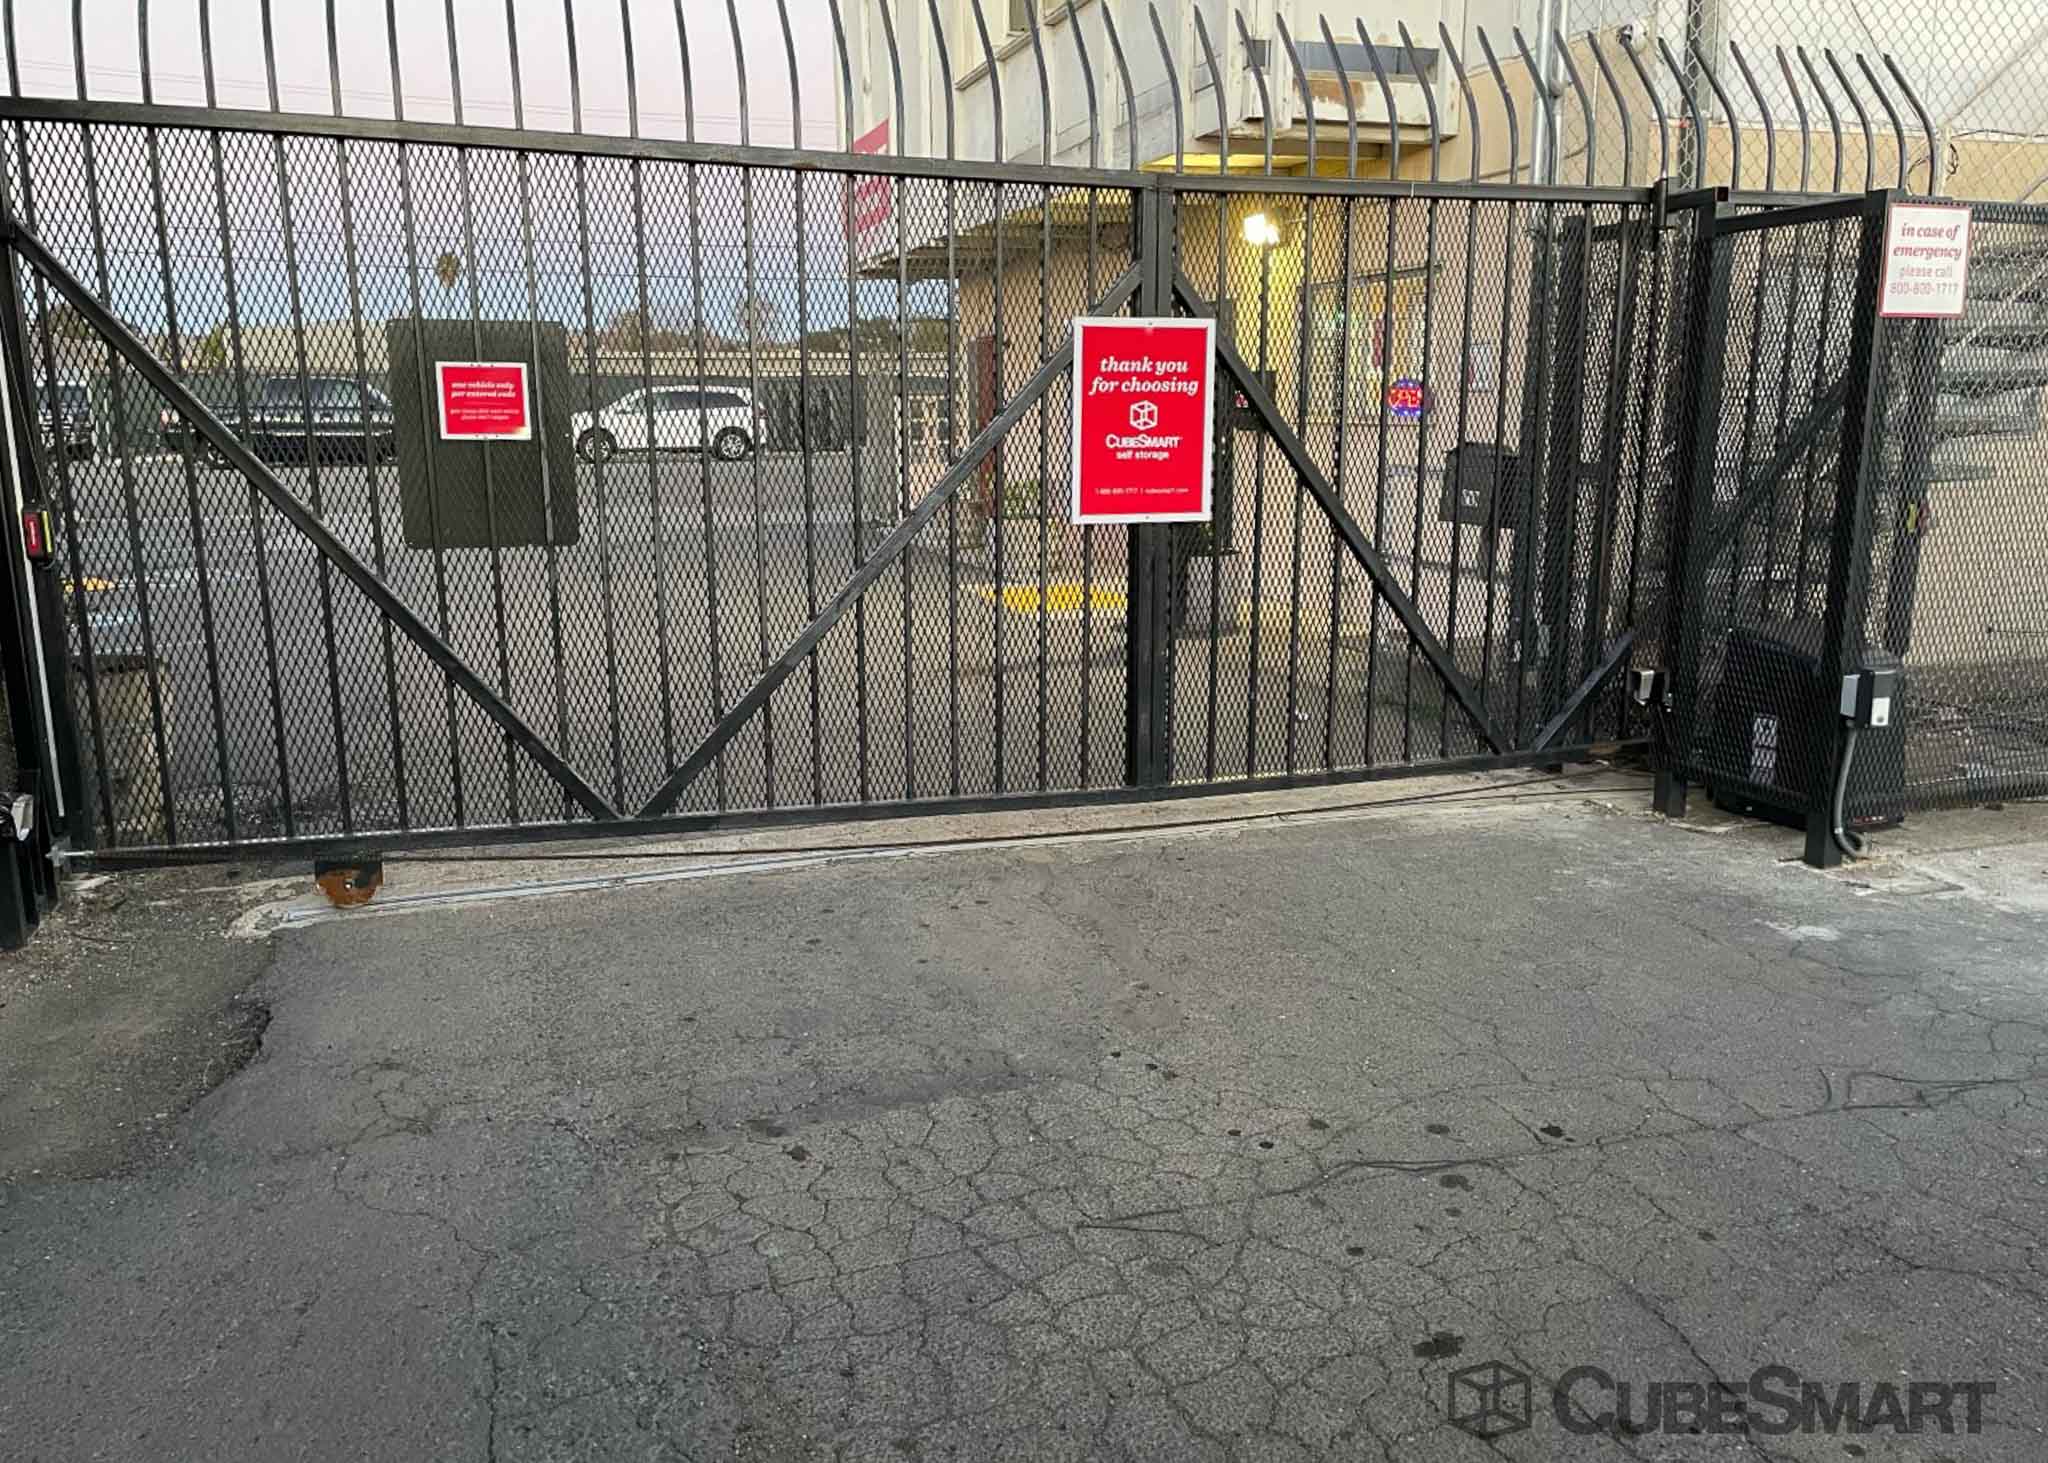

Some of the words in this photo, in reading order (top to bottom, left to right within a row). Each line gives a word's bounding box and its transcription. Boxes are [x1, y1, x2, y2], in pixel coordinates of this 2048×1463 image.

[1901, 222, 1915, 237] in
[1917, 226, 1944, 238] case
[1945, 225, 1960, 240] of
[1893, 246, 1962, 261] emergency
[1899, 264, 1932, 278] please
[1935, 264, 1953, 278] call
[1100, 356, 1153, 373] thank
[1155, 359, 1189, 375] you
[1088, 377, 1120, 396] for
[1121, 376, 1199, 396] choosing
[1116, 450, 1132, 460] self
[1135, 451, 1170, 461] storage
